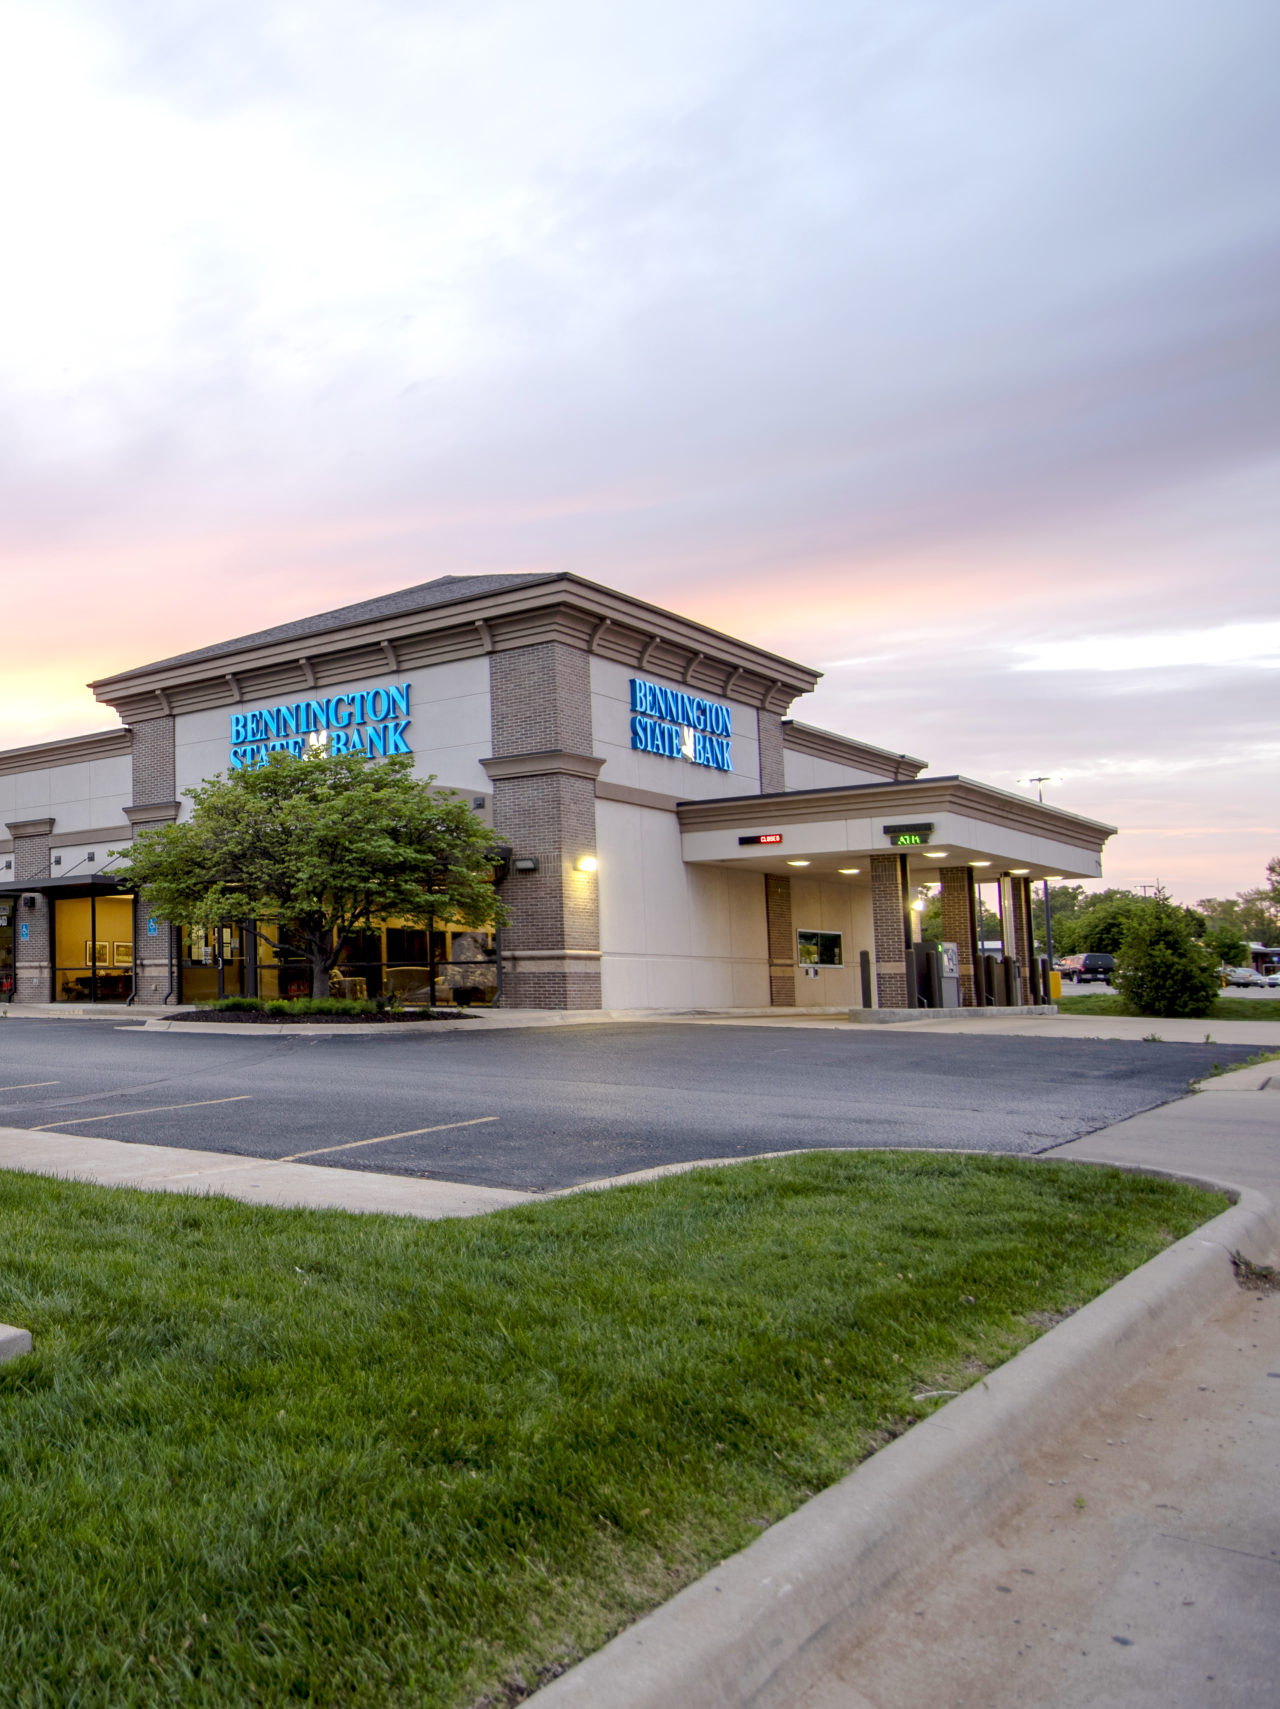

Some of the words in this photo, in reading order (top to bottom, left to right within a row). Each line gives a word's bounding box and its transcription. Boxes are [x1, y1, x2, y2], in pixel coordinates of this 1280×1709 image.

[230, 683, 411, 744] BENNINGTON
[630, 678, 732, 737] BENNINGTON
[329, 719, 413, 759] BANK
[631, 716, 683, 758] STATE
[692, 731, 734, 772] BANK
[760, 835, 781, 843] CLOSED
